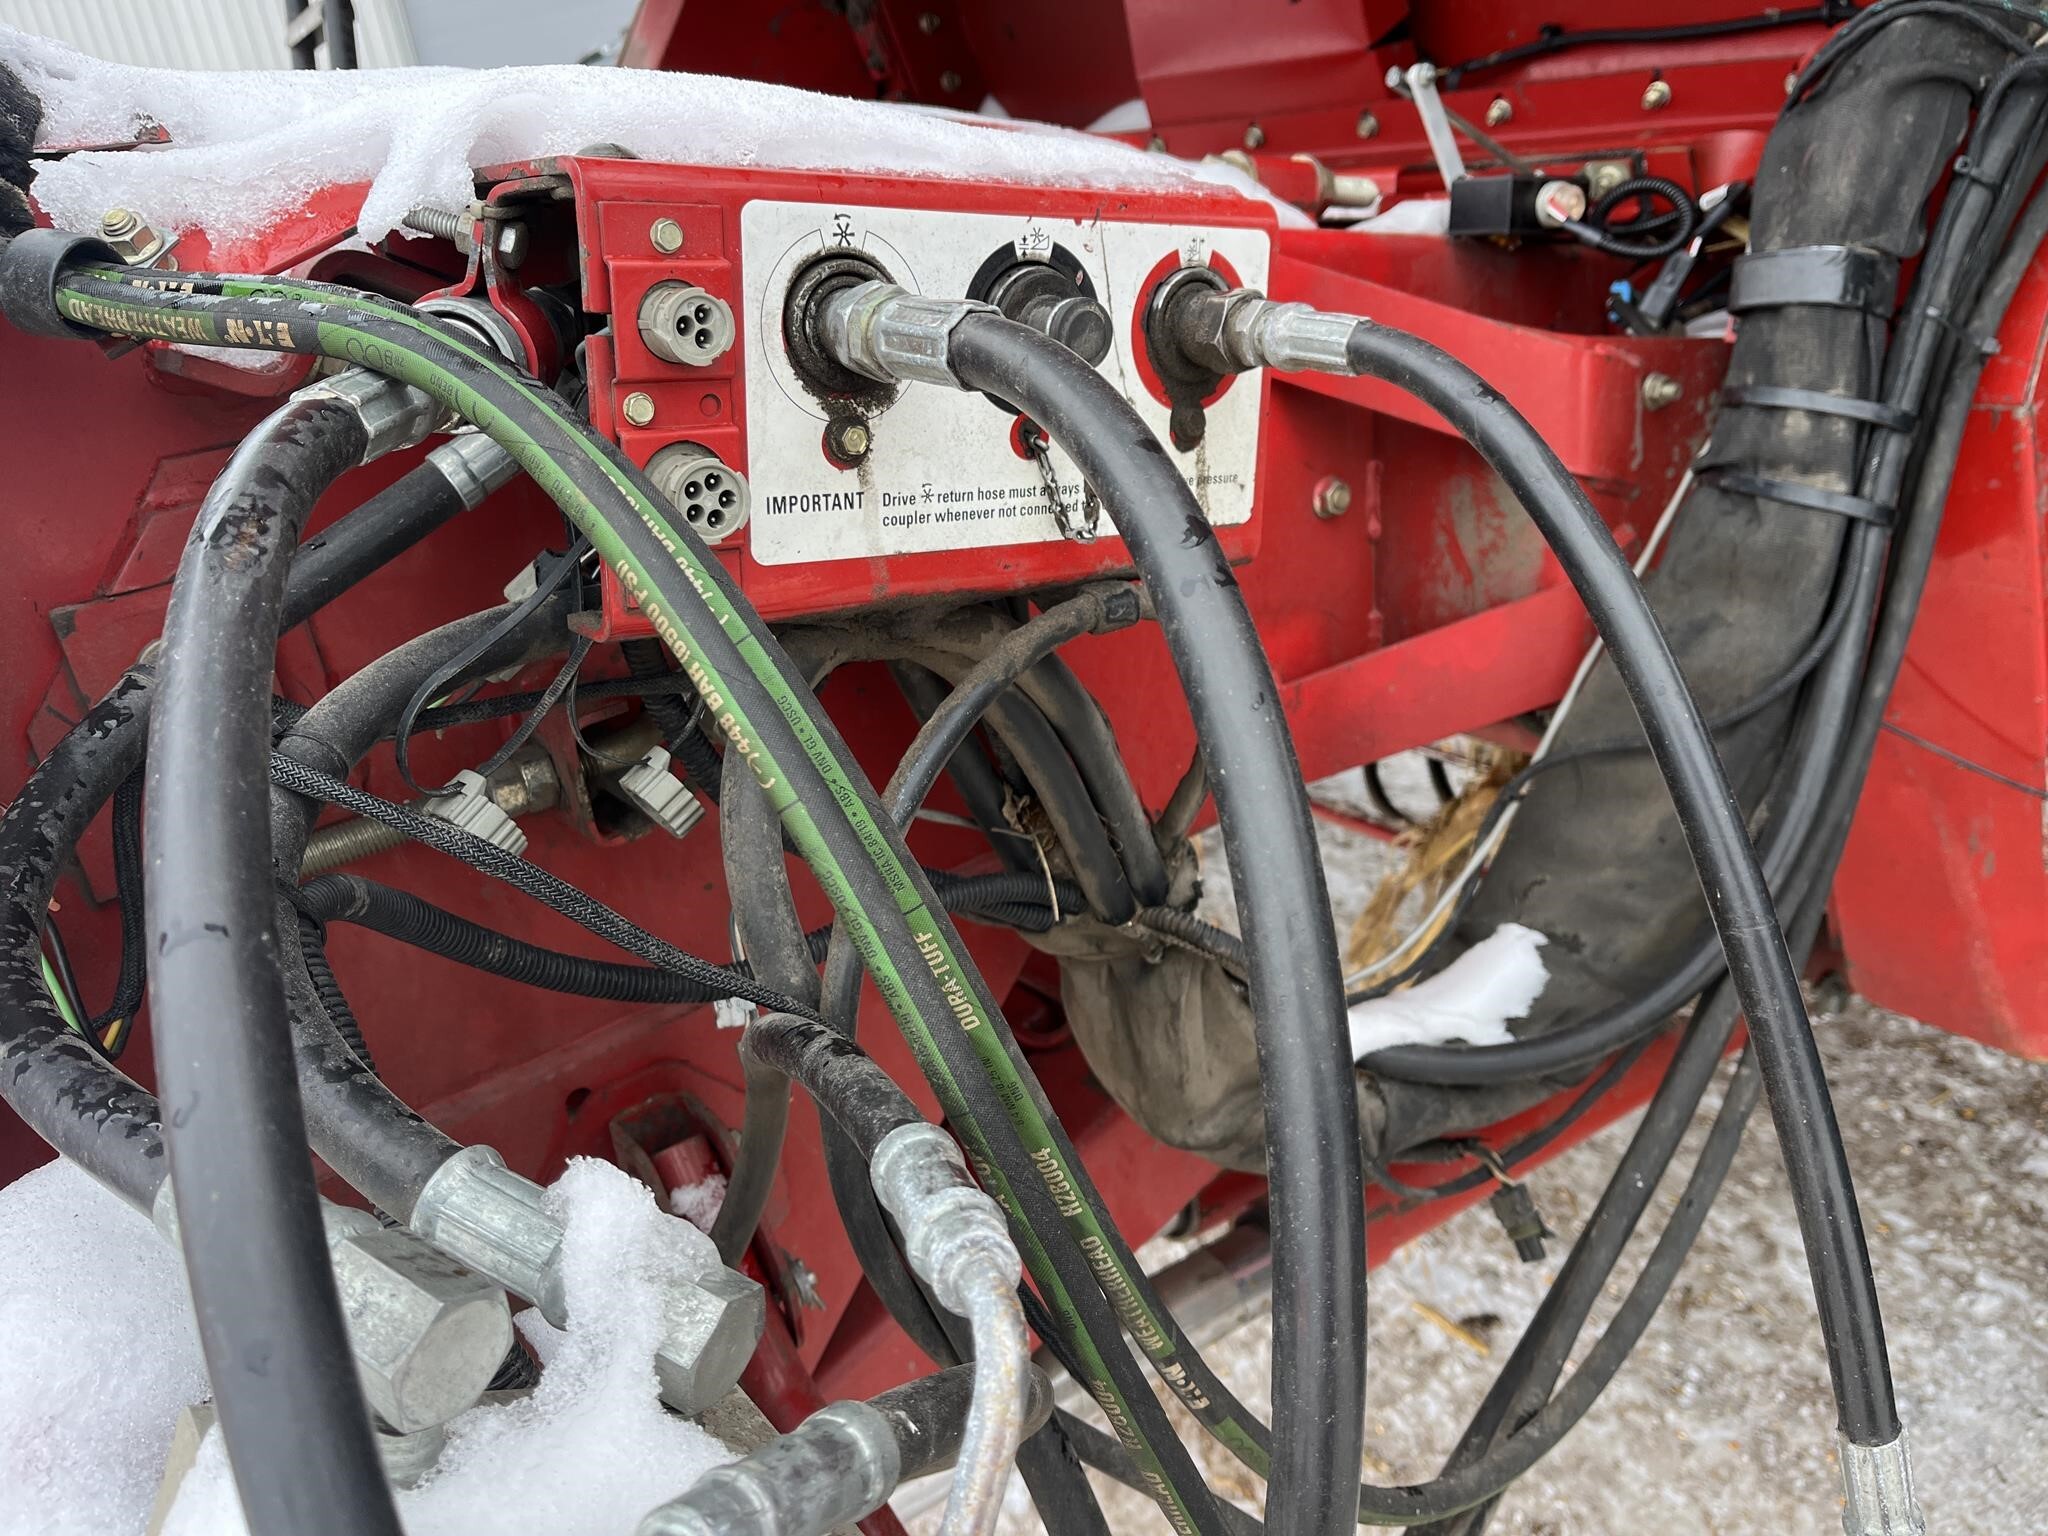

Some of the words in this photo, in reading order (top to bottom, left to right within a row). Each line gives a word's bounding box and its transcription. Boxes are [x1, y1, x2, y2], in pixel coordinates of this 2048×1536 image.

[766, 491, 865, 515] IMPORTANT
[882, 492, 916, 507] Drive
[937, 488, 974, 503] return
[977, 486, 1006, 501] hose
[1008, 484, 1037, 499] must
[882, 507, 932, 529] coupler
[935, 506, 995, 523] whenever
[998, 505, 1017, 519] not
[687, 662, 724, 712] BAR
[777, 695, 802, 727] USCG
[804, 735, 818, 751] GL
[813, 749, 833, 775] DNV
[835, 785, 855, 808] ABS
[871, 847, 884, 862] IC
[881, 859, 905, 892] MSHA
[914, 931, 981, 1031] DURA-TUFF
[1031, 1147, 1083, 1218] H28004
[1080, 1236, 1164, 1351] WEATHERHEAD
